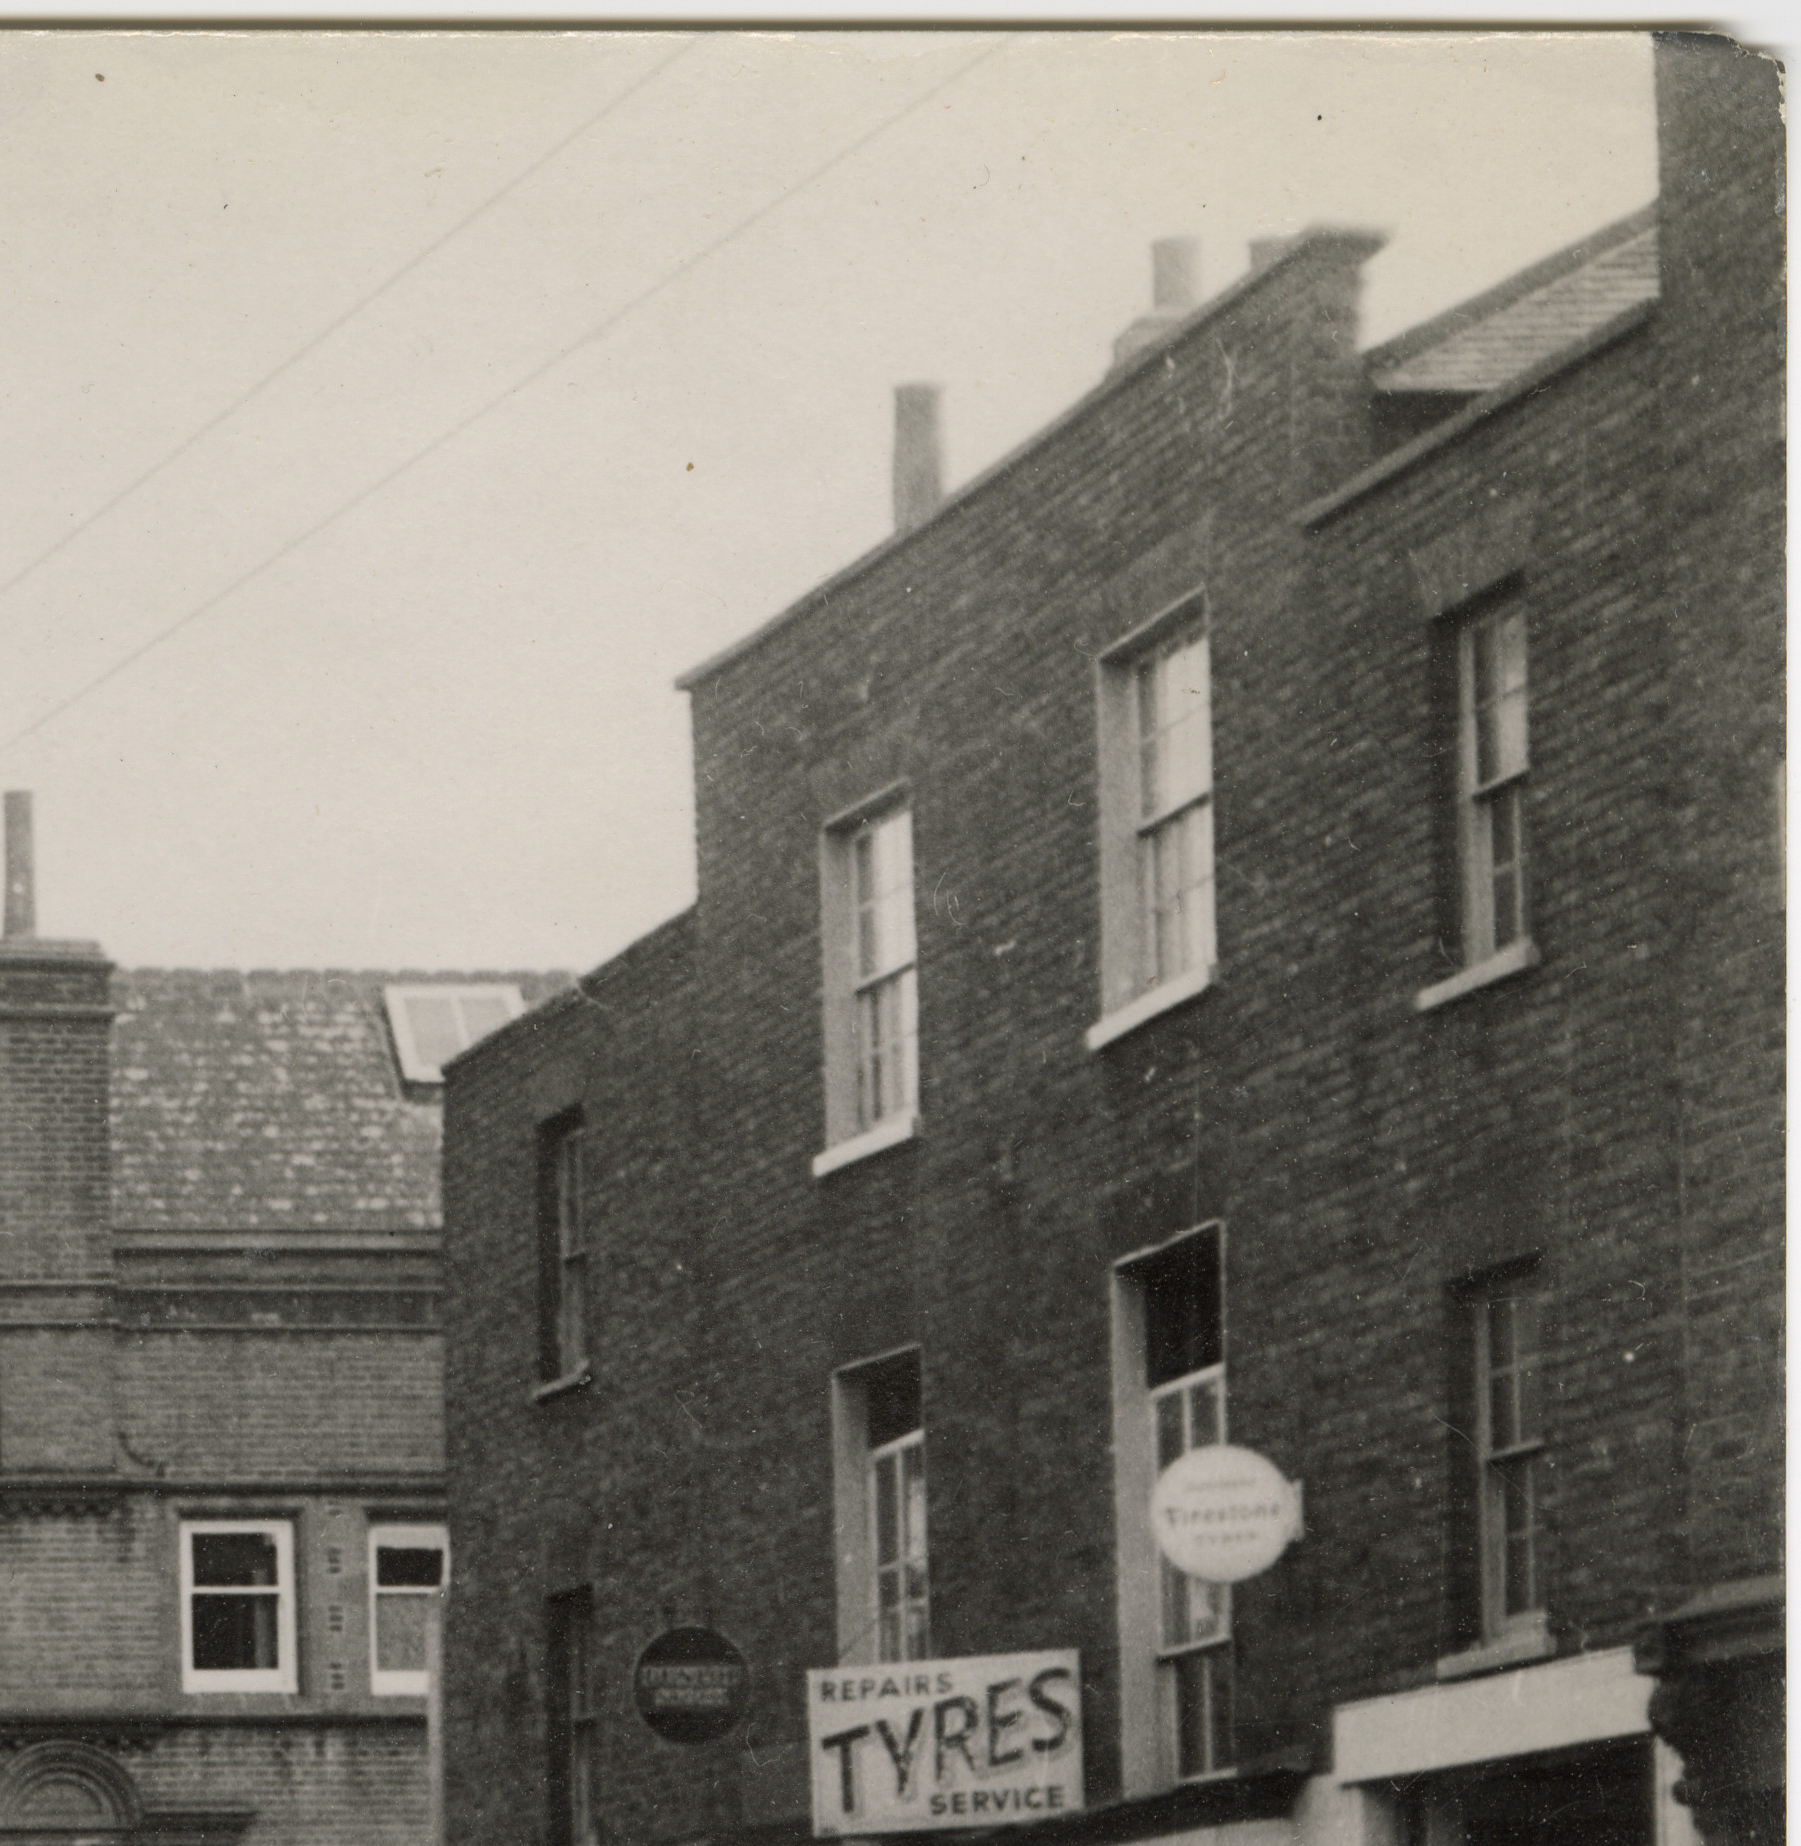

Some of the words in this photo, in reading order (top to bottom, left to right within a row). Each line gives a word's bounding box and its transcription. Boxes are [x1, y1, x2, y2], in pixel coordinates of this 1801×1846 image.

[820, 1673, 953, 1701] REPAIRS
[821, 1666, 1073, 1815] TYRES
[930, 1786, 1065, 1816] SERVICE
